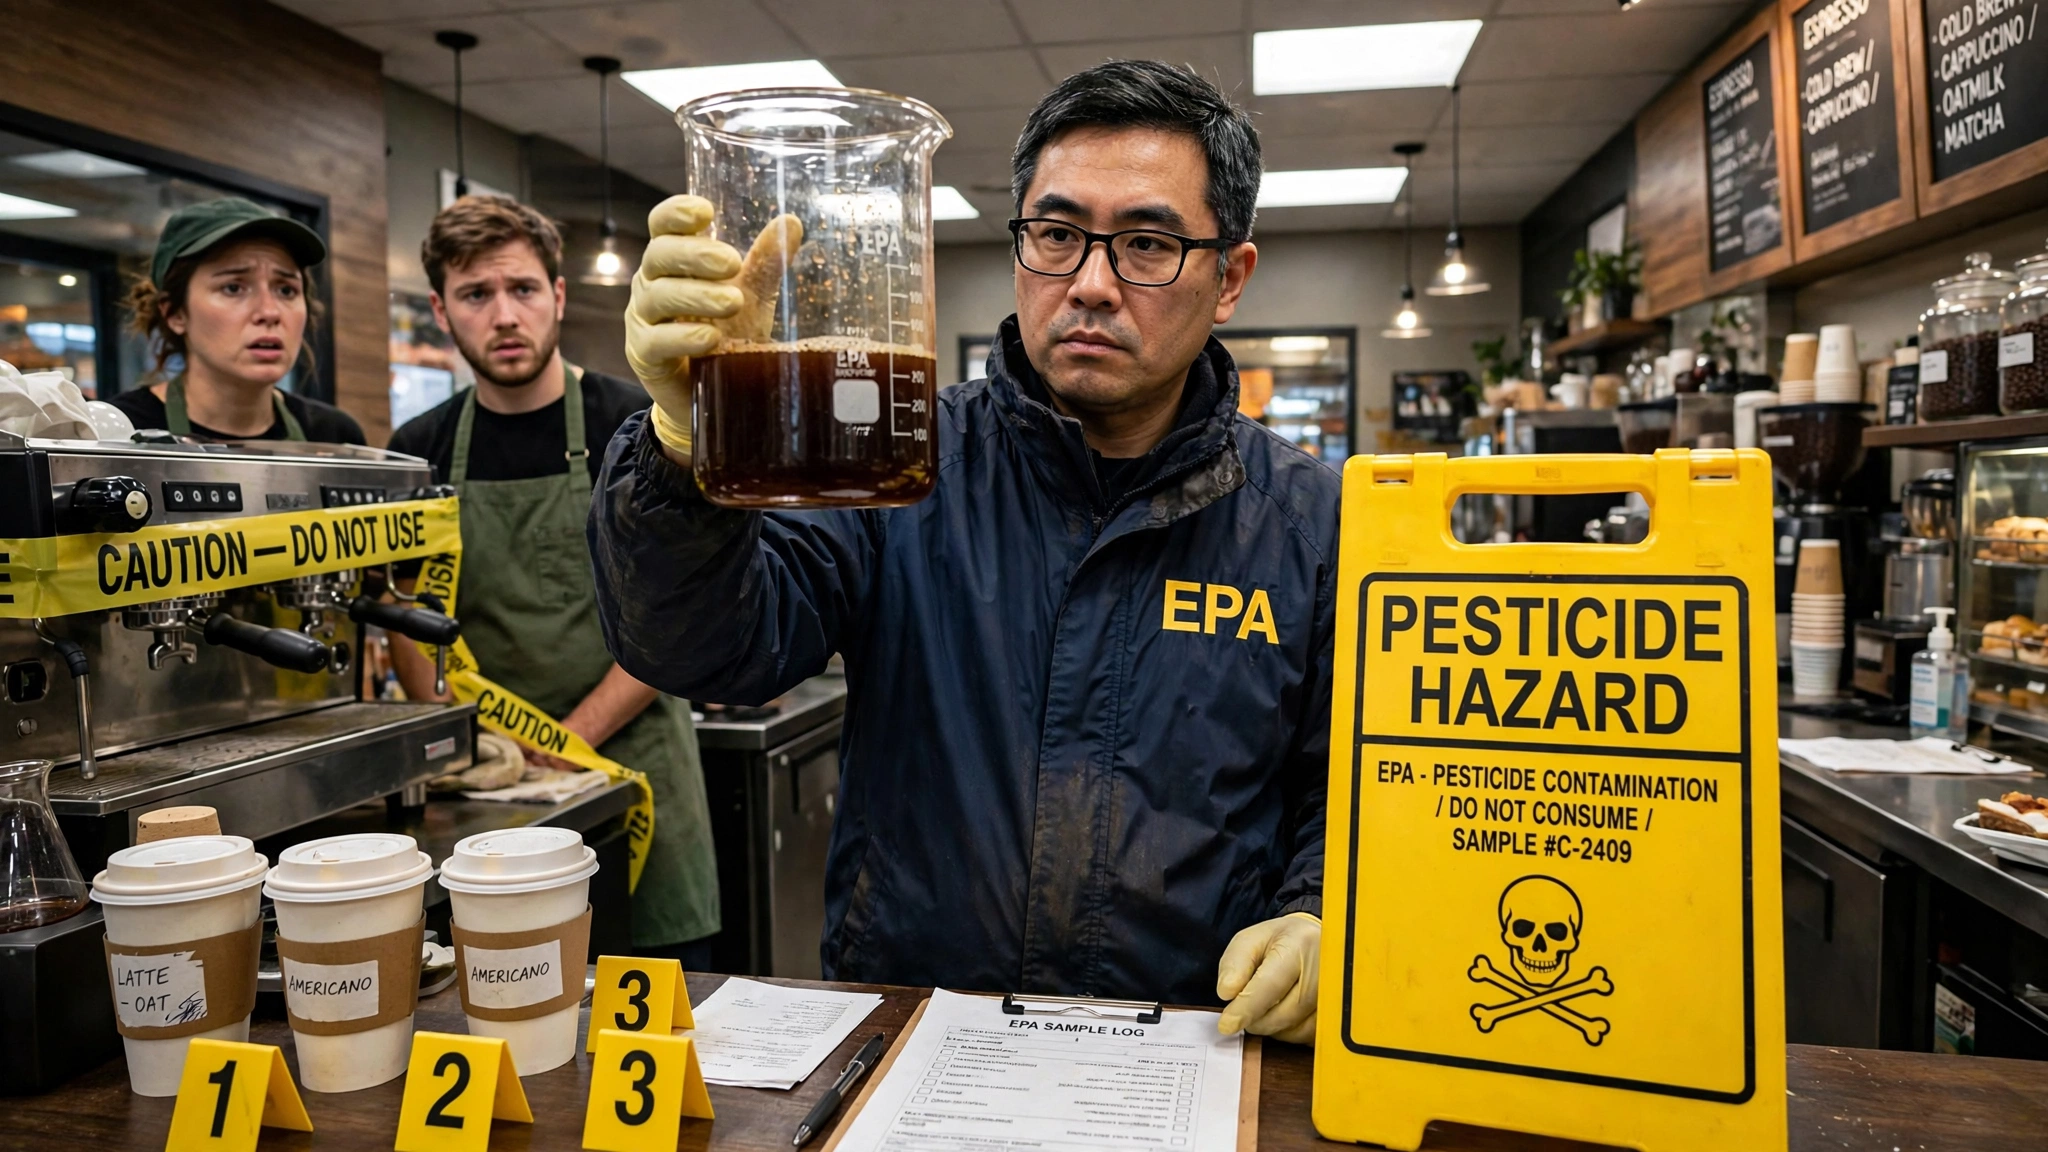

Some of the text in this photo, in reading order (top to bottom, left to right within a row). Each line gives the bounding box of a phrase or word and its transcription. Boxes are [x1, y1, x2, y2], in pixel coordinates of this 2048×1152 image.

[1938, 5, 1974, 47] COLD
[1940, 15, 2025, 82] CAPPUCCINO
[1805, 67, 1834, 104] COLD
[1942, 62, 2006, 118] OATMILK
[1944, 102, 2006, 154] MATCHA
[861, 230, 903, 257] EPA
[836, 348, 871, 368] EPA
[98, 531, 248, 595] CAUTION
[291, 521, 327, 566] DO
[335, 516, 378, 559] NOT
[385, 510, 426, 551] USE
[1162, 579, 1279, 644] EPA
[1381, 595, 1723, 662] PESTICIDE
[477, 689, 568, 753] CAUTION
[1410, 666, 1688, 735] HAZARD
[1377, 761, 1415, 784] EPA
[1433, 763, 1536, 791] PESTICIDE
[1543, 770, 1718, 803] CONTAMINATION
[1449, 796, 1478, 820] DO
[1485, 798, 1527, 822] NOT
[1532, 801, 1638, 831] CONSUME
[1452, 827, 1632, 864] SAMPLE #C-2409
[118, 966, 170, 987] LATTE
[289, 975, 372, 995] AMERICANO
[471, 962, 550, 983] AMERICANO
[135, 994, 171, 1012] OAT
[614, 969, 651, 1032] 3
[1009, 1019, 1145, 1037] EPA SAMPLE LOG
[208, 1060, 238, 1139] 1
[425, 1051, 471, 1130] 2
[614, 1049, 657, 1126] 3
